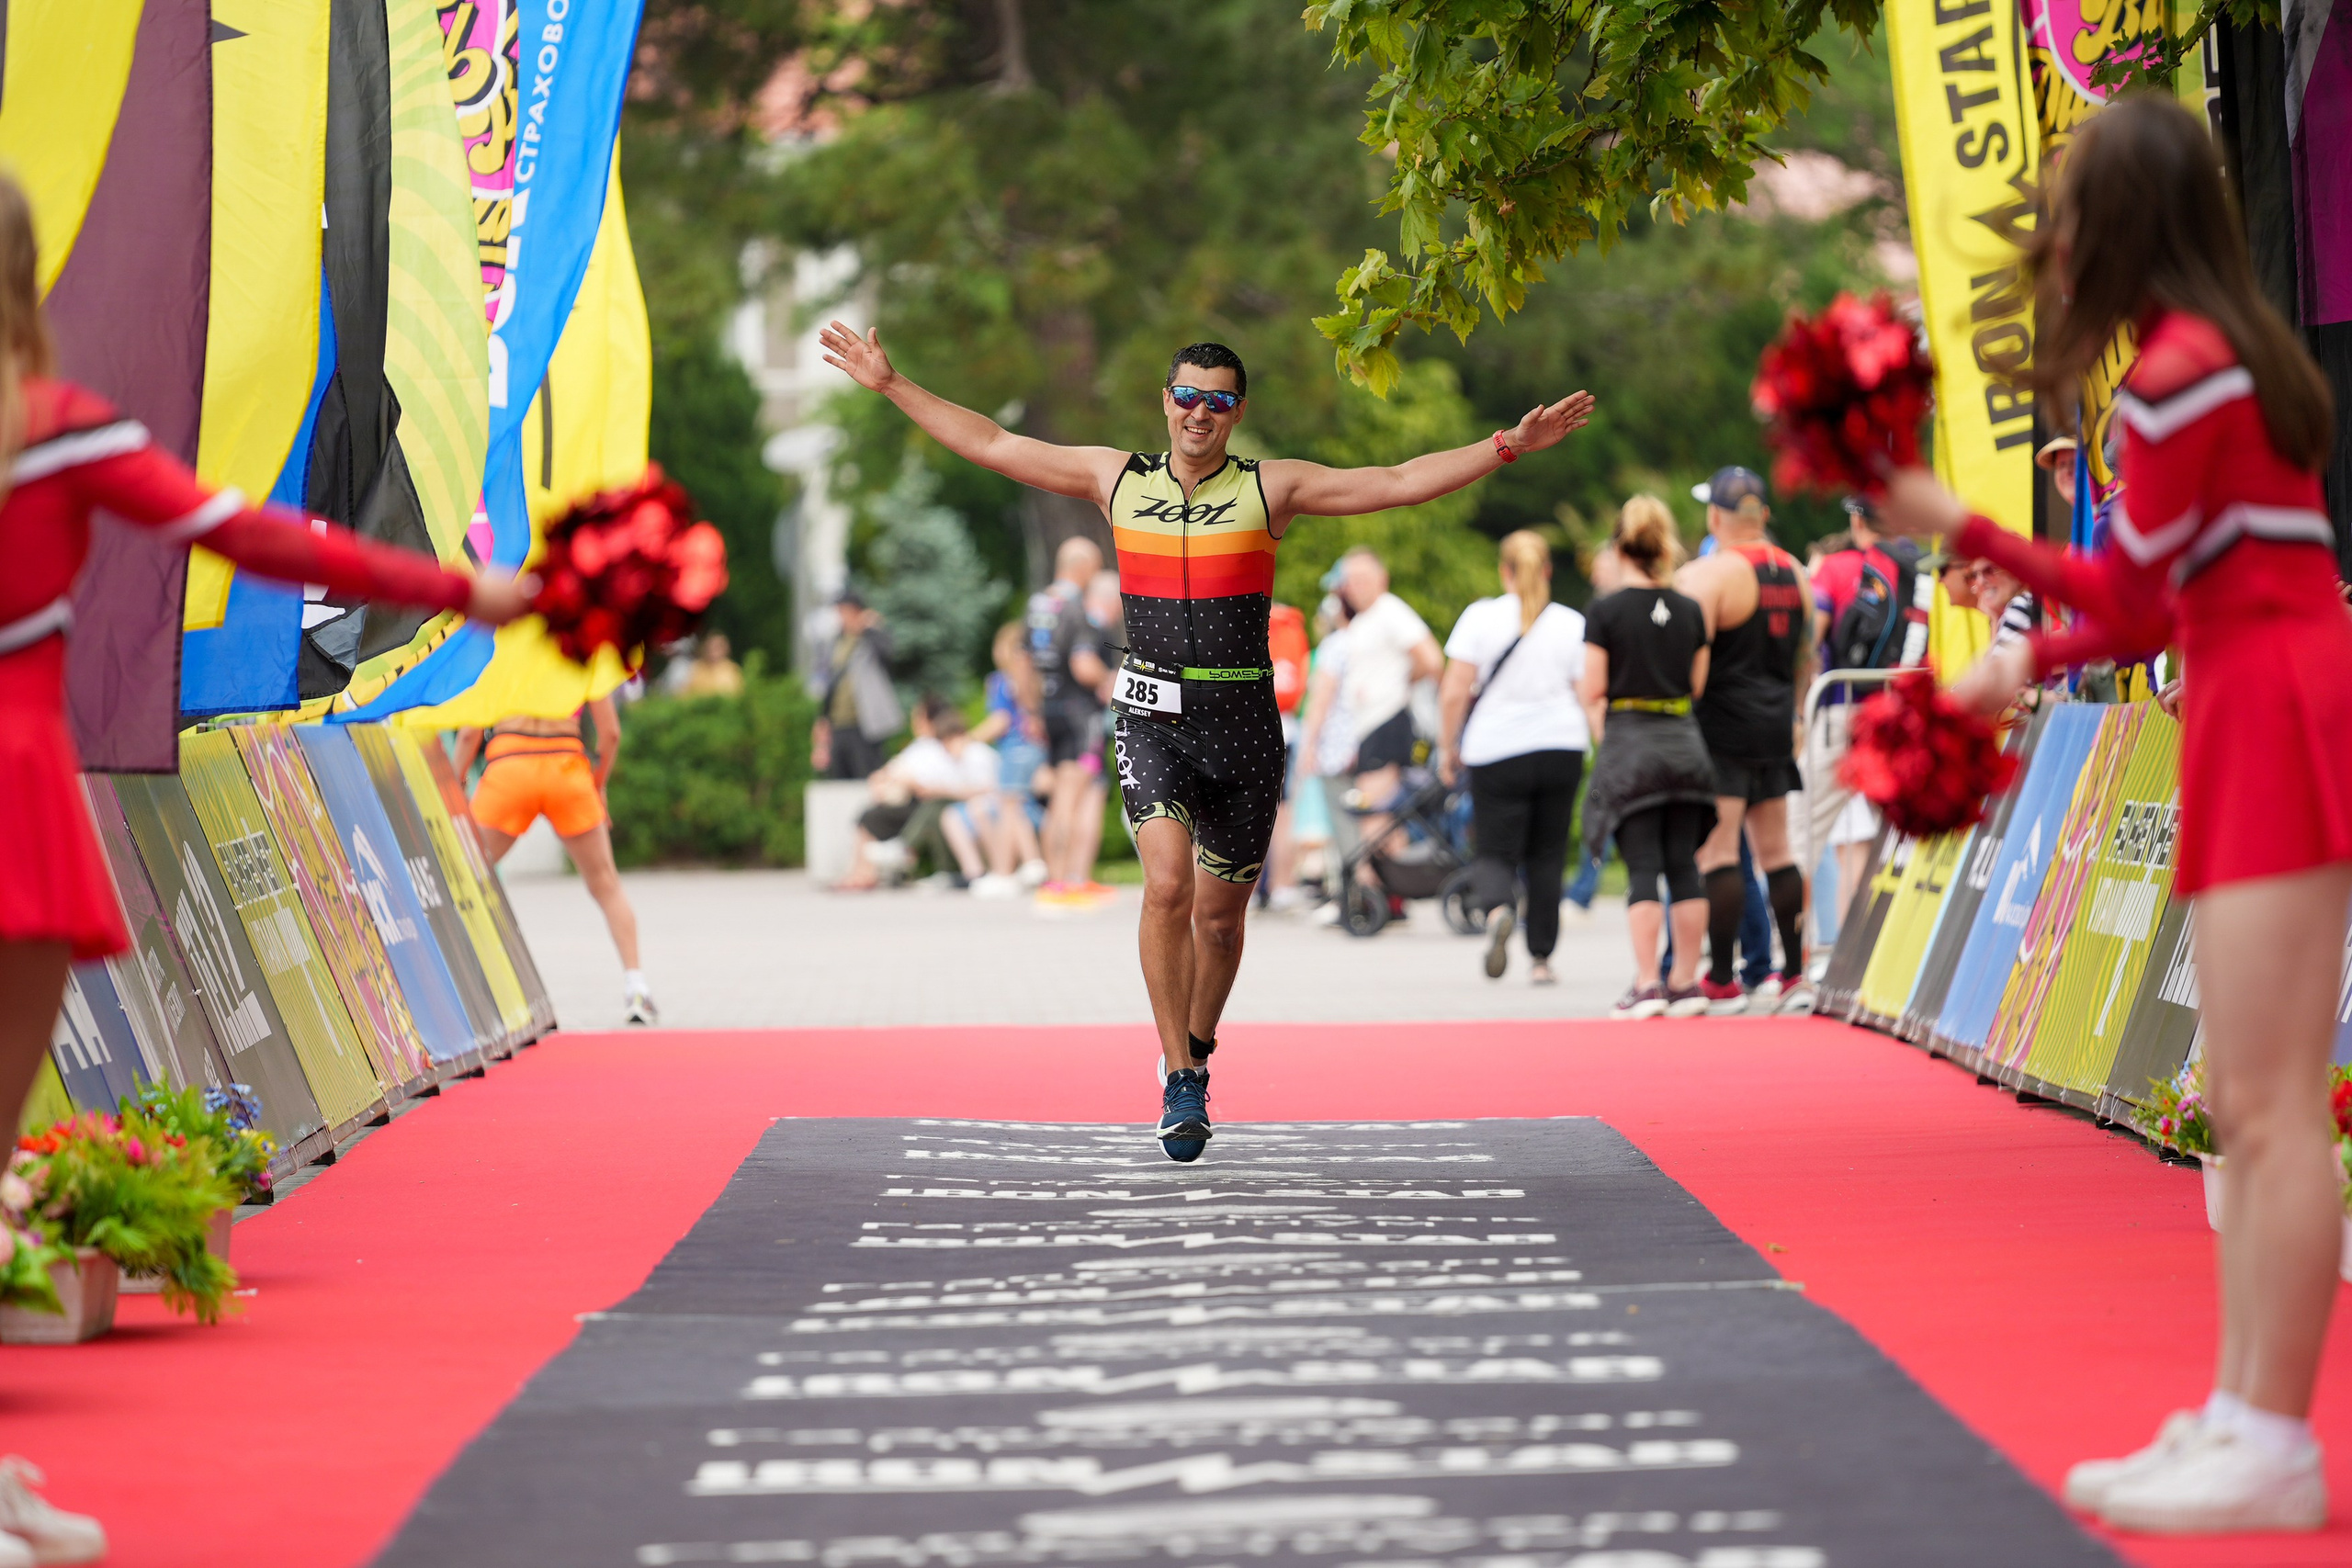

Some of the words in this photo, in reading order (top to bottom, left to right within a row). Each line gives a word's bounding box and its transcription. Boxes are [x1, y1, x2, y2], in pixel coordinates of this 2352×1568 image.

[1125, 677, 1159, 705] 285
[1128, 706, 1151, 717] ALEKSEY
[1263, 1189, 1525, 1198] STAR
